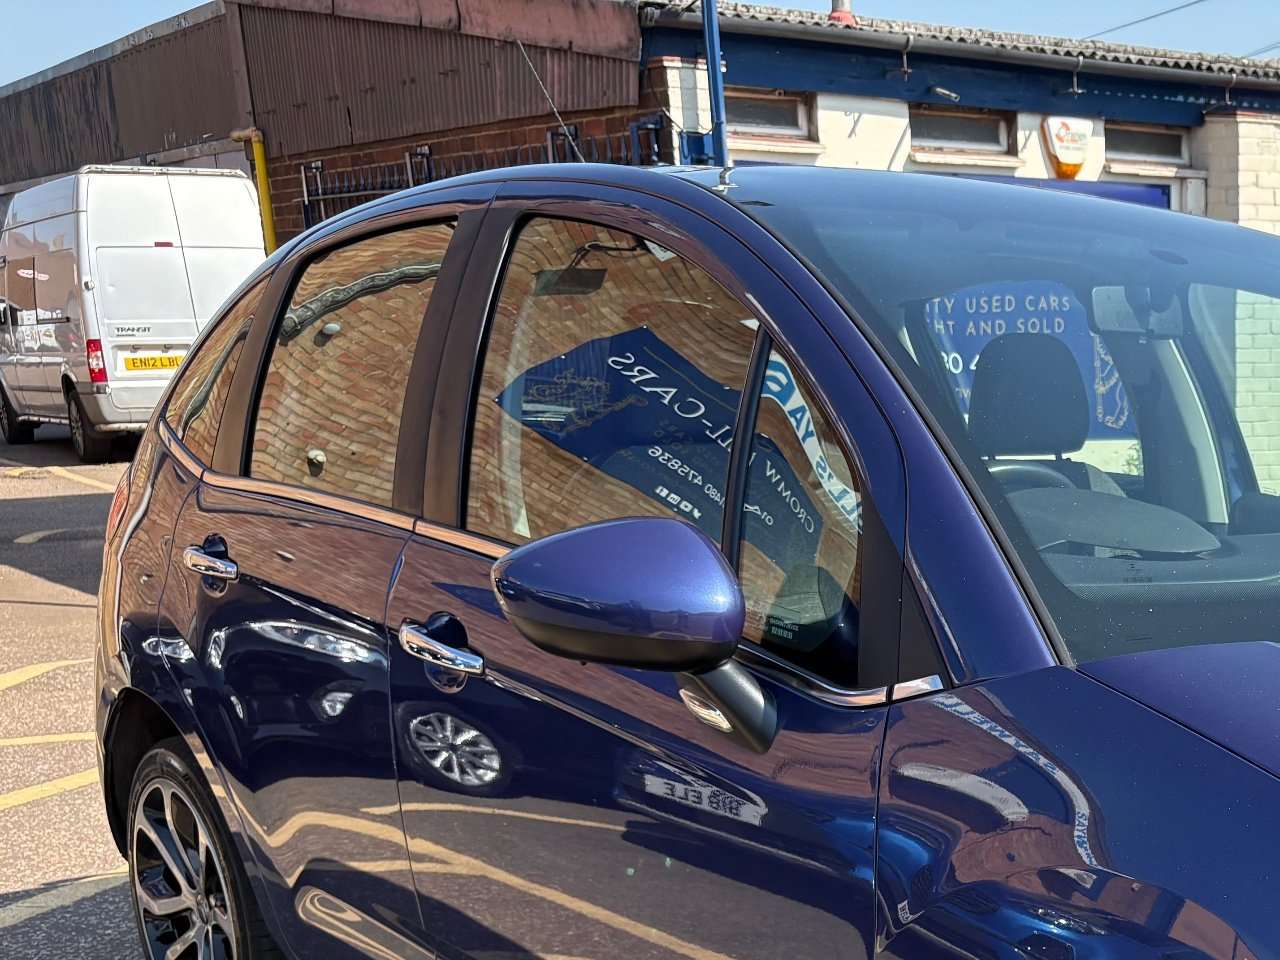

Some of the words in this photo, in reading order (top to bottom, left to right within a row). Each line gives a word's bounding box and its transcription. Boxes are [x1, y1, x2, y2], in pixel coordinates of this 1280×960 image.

[965, 295, 1016, 313] USED
[1025, 295, 1071, 311] CARS
[966, 320, 1006, 336] AND
[1017, 318, 1065, 334] SOLD
